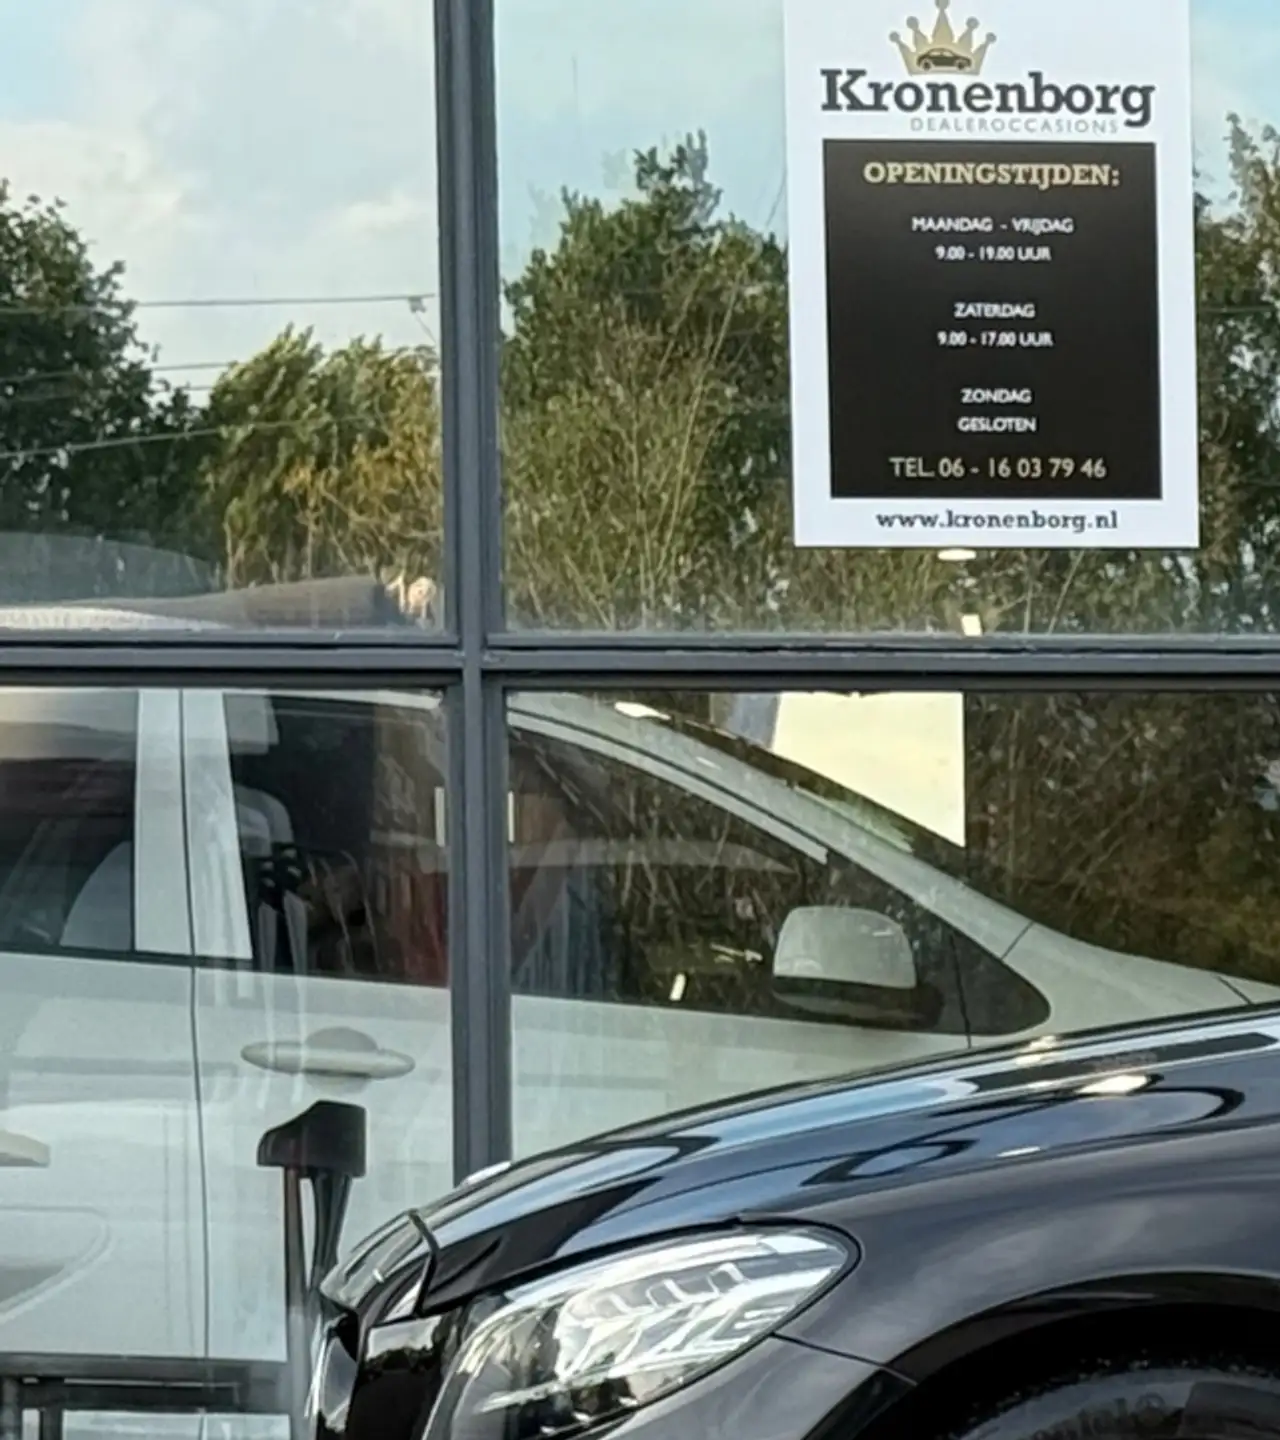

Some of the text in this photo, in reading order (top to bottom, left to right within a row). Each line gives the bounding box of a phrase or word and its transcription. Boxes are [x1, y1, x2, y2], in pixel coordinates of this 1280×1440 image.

[820, 69, 1155, 127] Kronenborg
[911, 117, 1119, 134] DEALEROCCASIONS
[864, 162, 1120, 190] OPENINGSTIJDEN:
[911, 216, 993, 232] MAANDAG
[1011, 217, 1074, 235] VRIJDAG
[935, 245, 965, 260] 9.00
[980, 245, 1014, 260] 19.00
[1018, 246, 1052, 261] UUR
[954, 302, 1036, 318] ZATERDAG
[937, 331, 967, 346] 9.00
[981, 331, 1016, 347] 17.00
[1019, 331, 1053, 347] UUR
[961, 388, 1031, 403] ZONDAG
[957, 416, 1037, 431] GESLOTEN
[889, 457, 935, 477] TEL.
[938, 457, 965, 477] 06
[989, 458, 1011, 477] 16
[1017, 457, 1042, 478] 03
[1048, 458, 1075, 478] 79
[1080, 458, 1107, 478] 46
[876, 509, 1118, 533] www.kronenborg.nl
